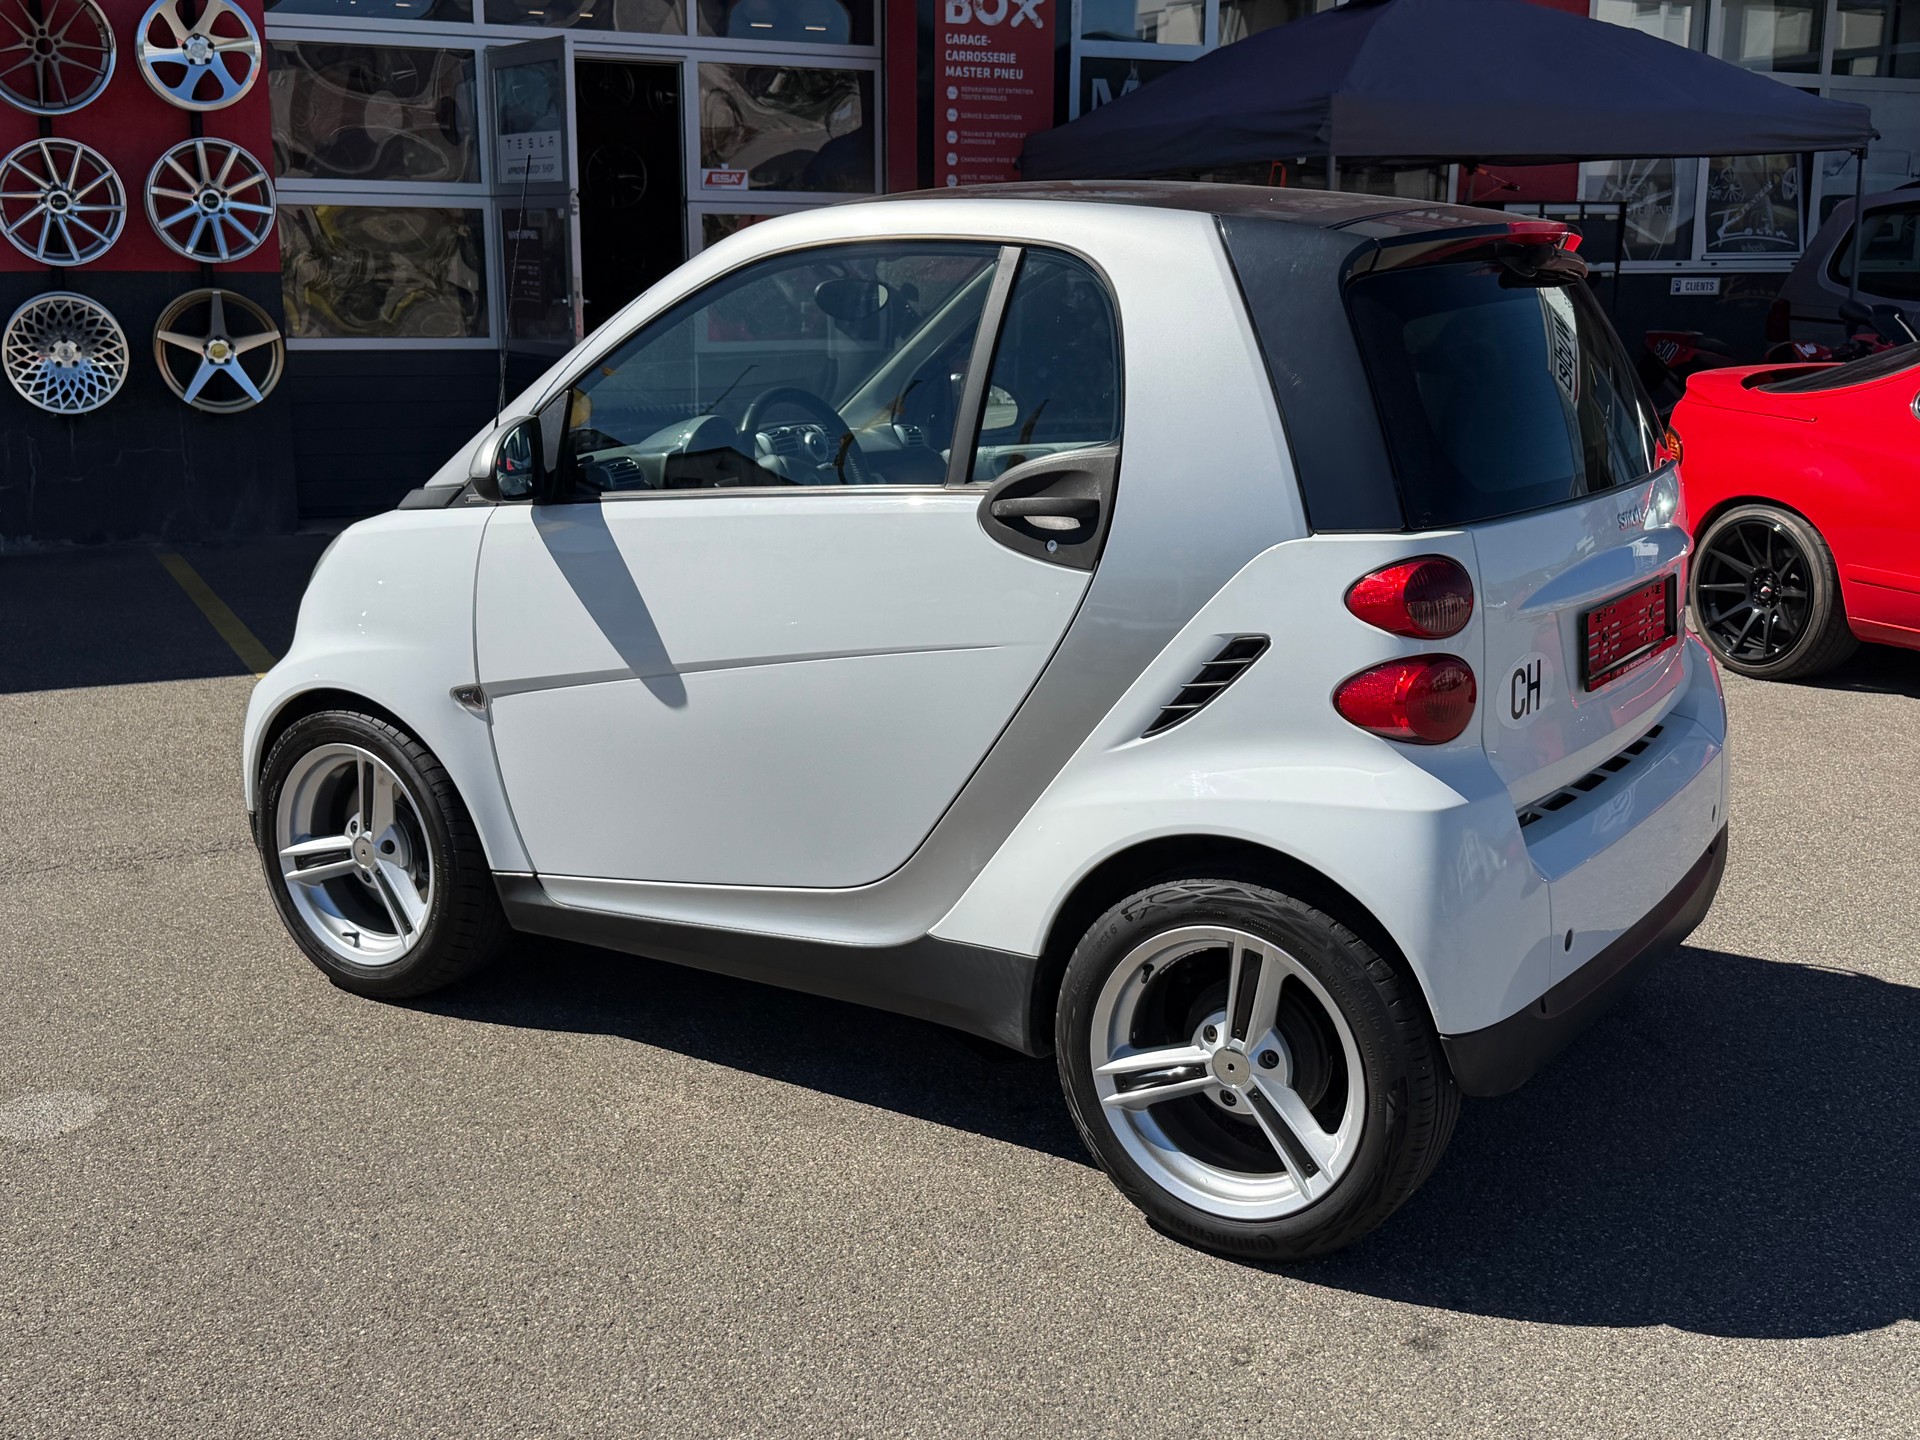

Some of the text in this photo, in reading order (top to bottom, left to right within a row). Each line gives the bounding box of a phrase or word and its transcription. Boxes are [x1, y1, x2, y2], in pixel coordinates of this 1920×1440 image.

[945, 0, 1043, 28] BOX
[945, 33, 991, 46] GARAGE-
[945, 50, 1016, 63] CARROSSERIE
[945, 66, 1023, 80] MASTER PNEU
[507, 136, 553, 150] TESLA
[1685, 281, 1714, 292] CLIENTS
[1511, 659, 1541, 720] CH
